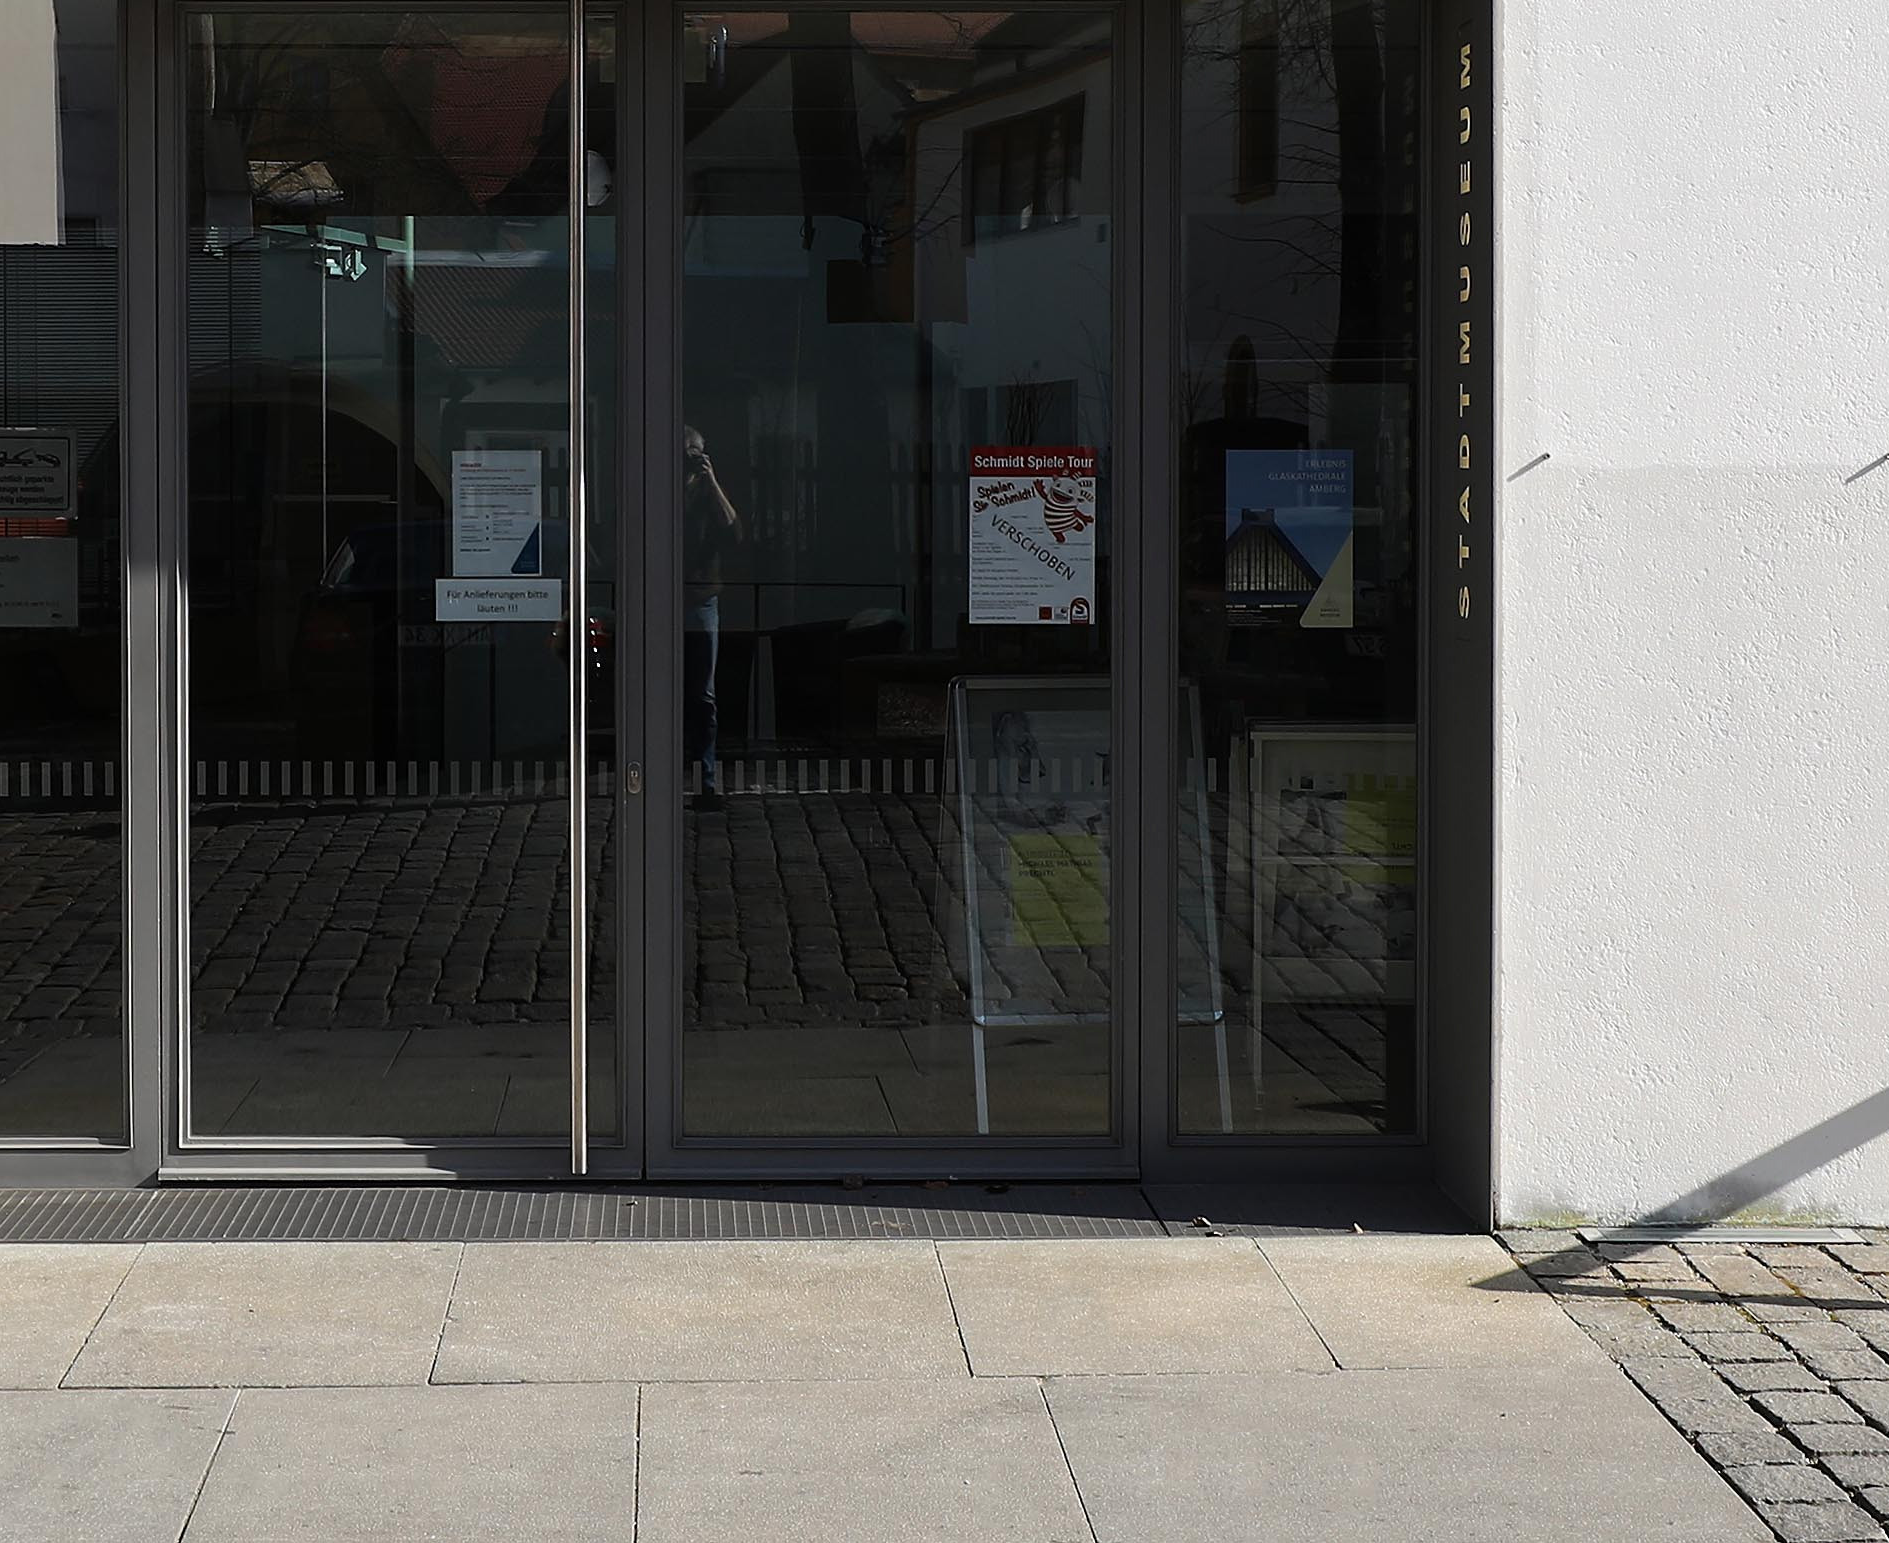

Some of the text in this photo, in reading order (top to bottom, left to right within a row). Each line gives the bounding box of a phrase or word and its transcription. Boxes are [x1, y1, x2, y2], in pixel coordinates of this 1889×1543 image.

[1457, 41, 1473, 621] STADTMUSEUM
[974, 455, 1095, 470] Schmidt Spiele Tour
[1309, 484, 1347, 494] AMBERG
[991, 514, 1076, 581] VERSCHOBEN
[446, 589, 550, 601] Für Anlieferungen bitte
[477, 604, 506, 613] läuten
